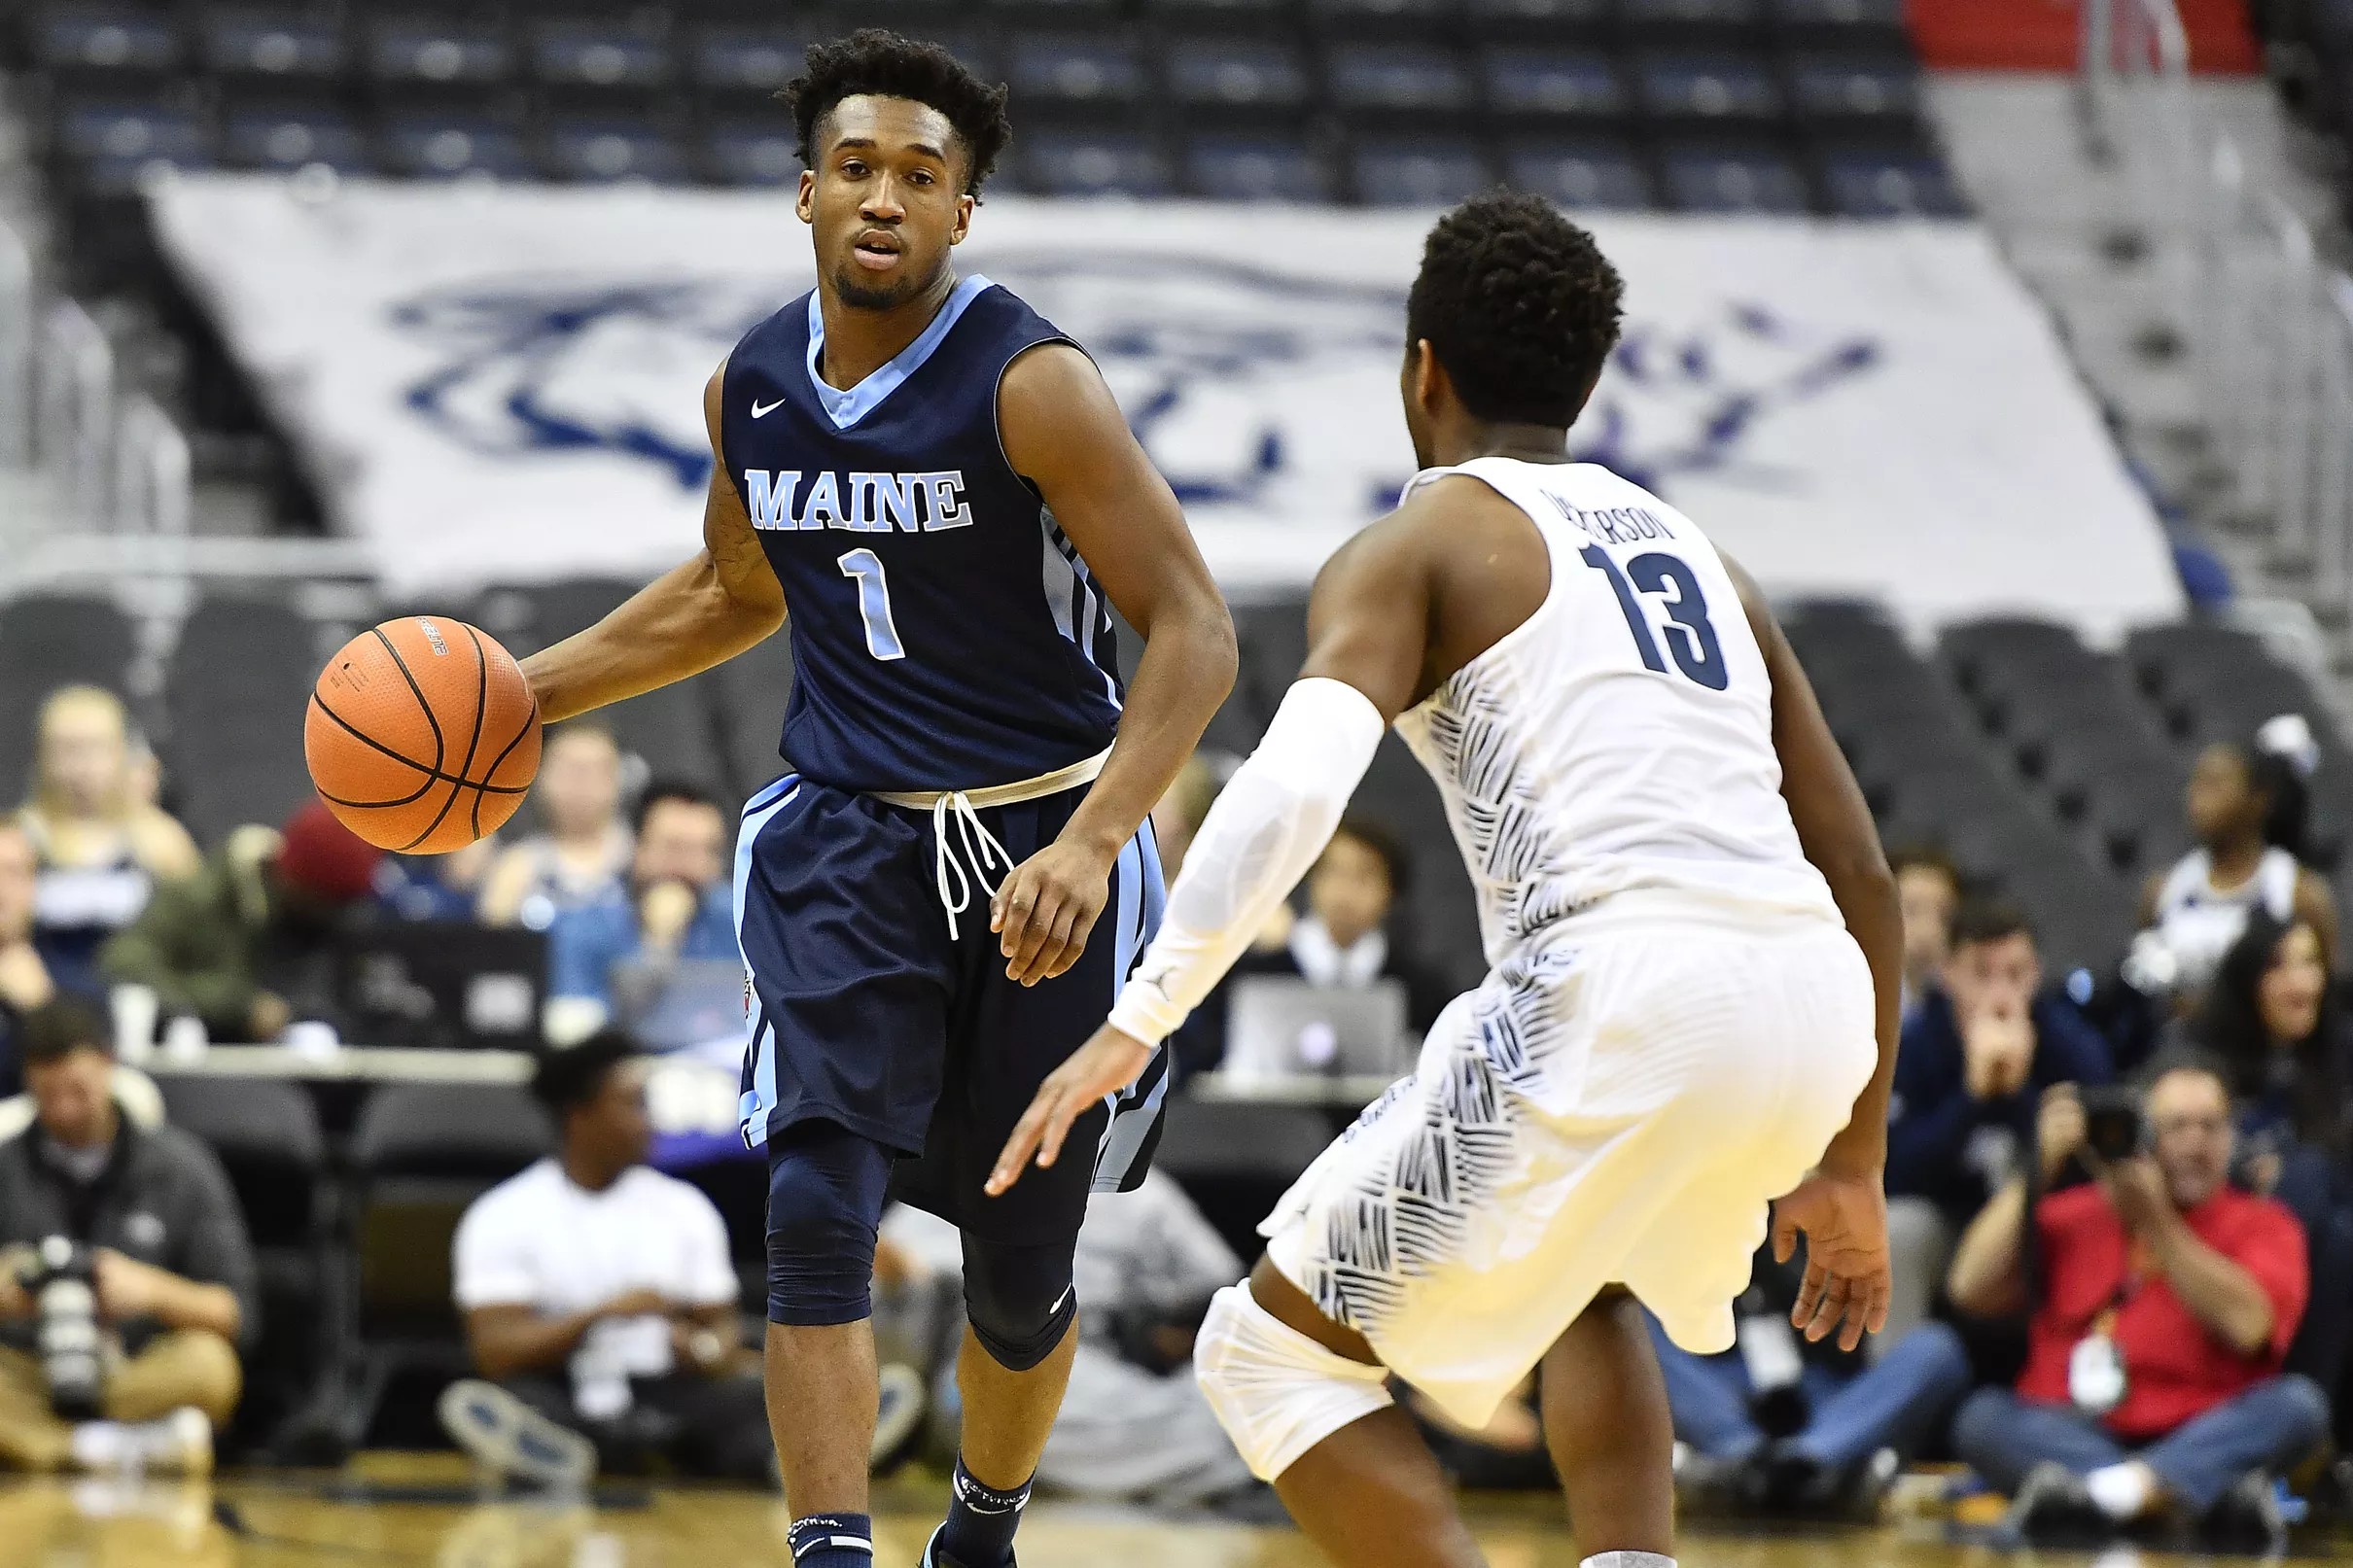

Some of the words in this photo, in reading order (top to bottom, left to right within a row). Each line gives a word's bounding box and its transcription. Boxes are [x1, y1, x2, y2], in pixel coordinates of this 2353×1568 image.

[744, 469, 973, 533] MAINE
[836, 547, 906, 661] 1
[1578, 540, 1729, 691] 13
